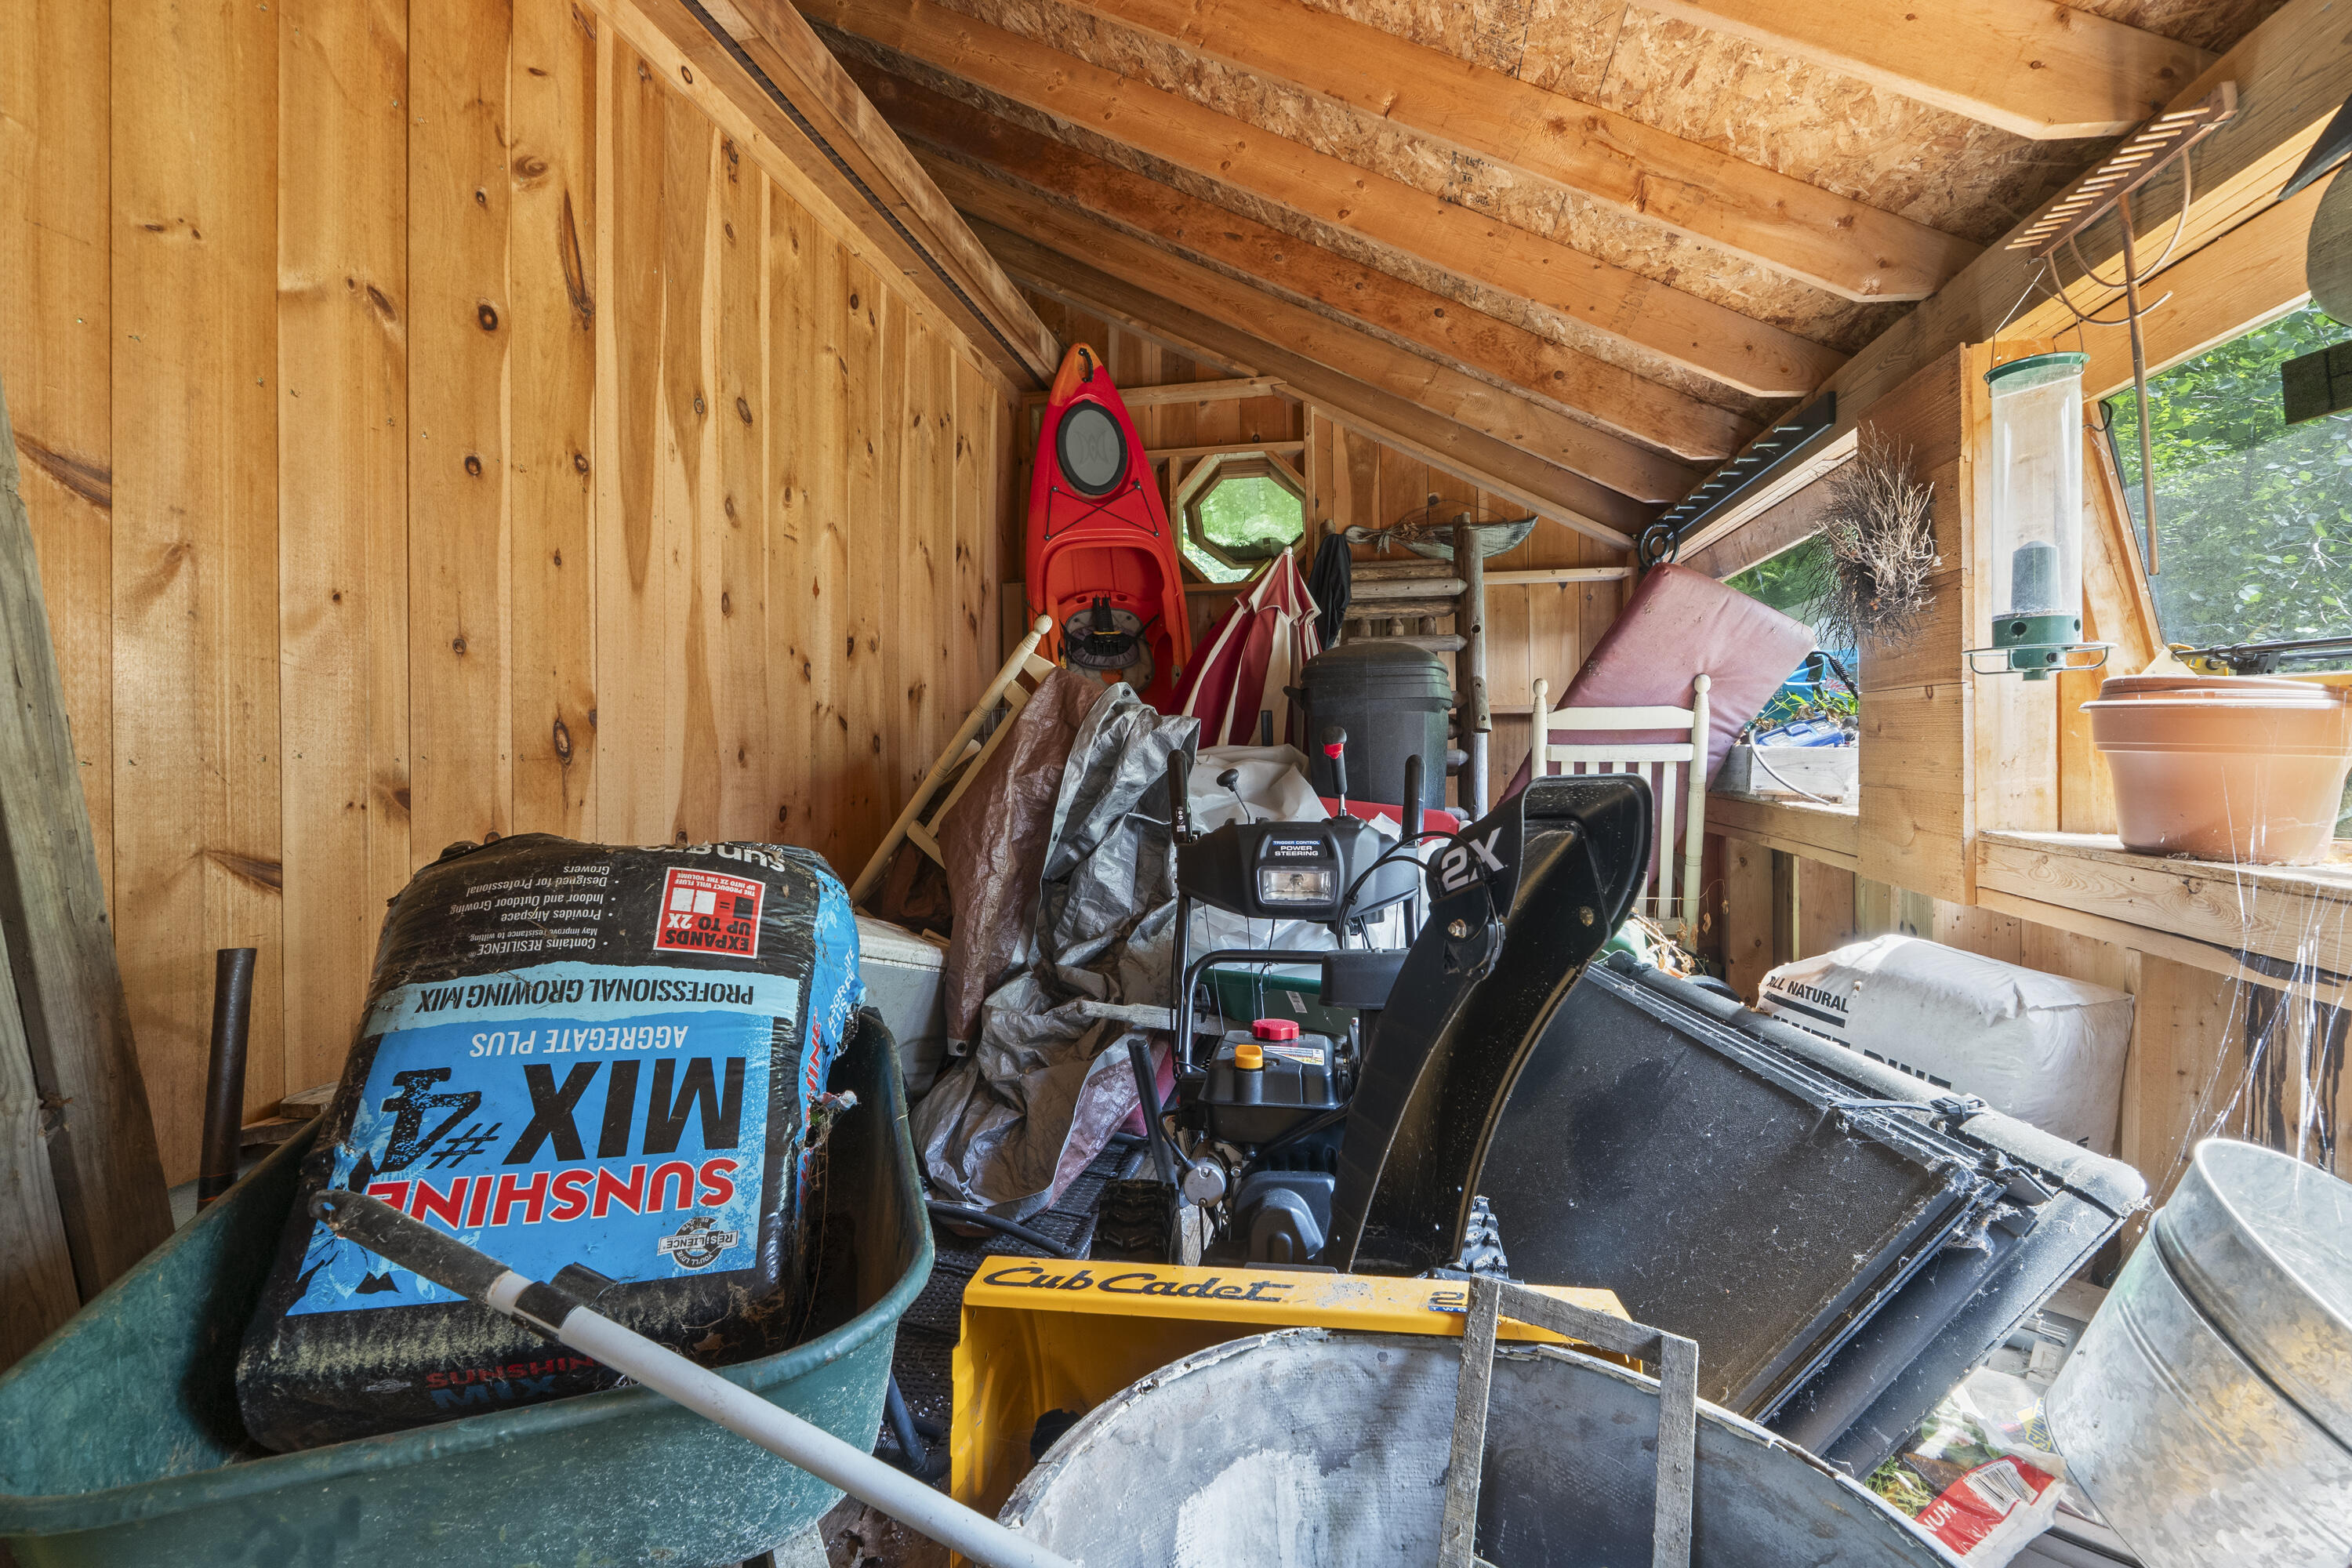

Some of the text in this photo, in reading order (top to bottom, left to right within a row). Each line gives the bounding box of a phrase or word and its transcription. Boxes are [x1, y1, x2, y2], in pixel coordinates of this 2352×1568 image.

[563, 866, 610, 875] Growers
[1441, 827, 1504, 892] 2X
[466, 875, 608, 897] Designed for Professional
[674, 878, 756, 897] THE PRODUCT WILL FLUFF
[677, 873, 705, 882] VOLUME
[706, 876, 718, 884] THE
[730, 879, 745, 889] INTO
[449, 894, 604, 916] Indoor and Outdoor Growing
[500, 909, 601, 922] Provides Airspace
[507, 929, 546, 938] resistance
[549, 927, 580, 936] improve
[580, 927, 597, 936] May
[666, 913, 751, 936] UP TO 2X
[546, 938, 596, 949] Contains
[665, 930, 750, 952] EXPANDS
[414, 977, 754, 1014] PROFESSIONAL GROWING MIX
[1787, 981, 1849, 1014] NATURAL
[469, 1024, 689, 1058] AGGREGATE PLUS
[373, 1055, 746, 1177] MIX #4
[983, 1267, 1295, 1302] Cub Cadet
[426, 1356, 603, 1388] SUNSHIN
[431, 1374, 557, 1408] MIX
